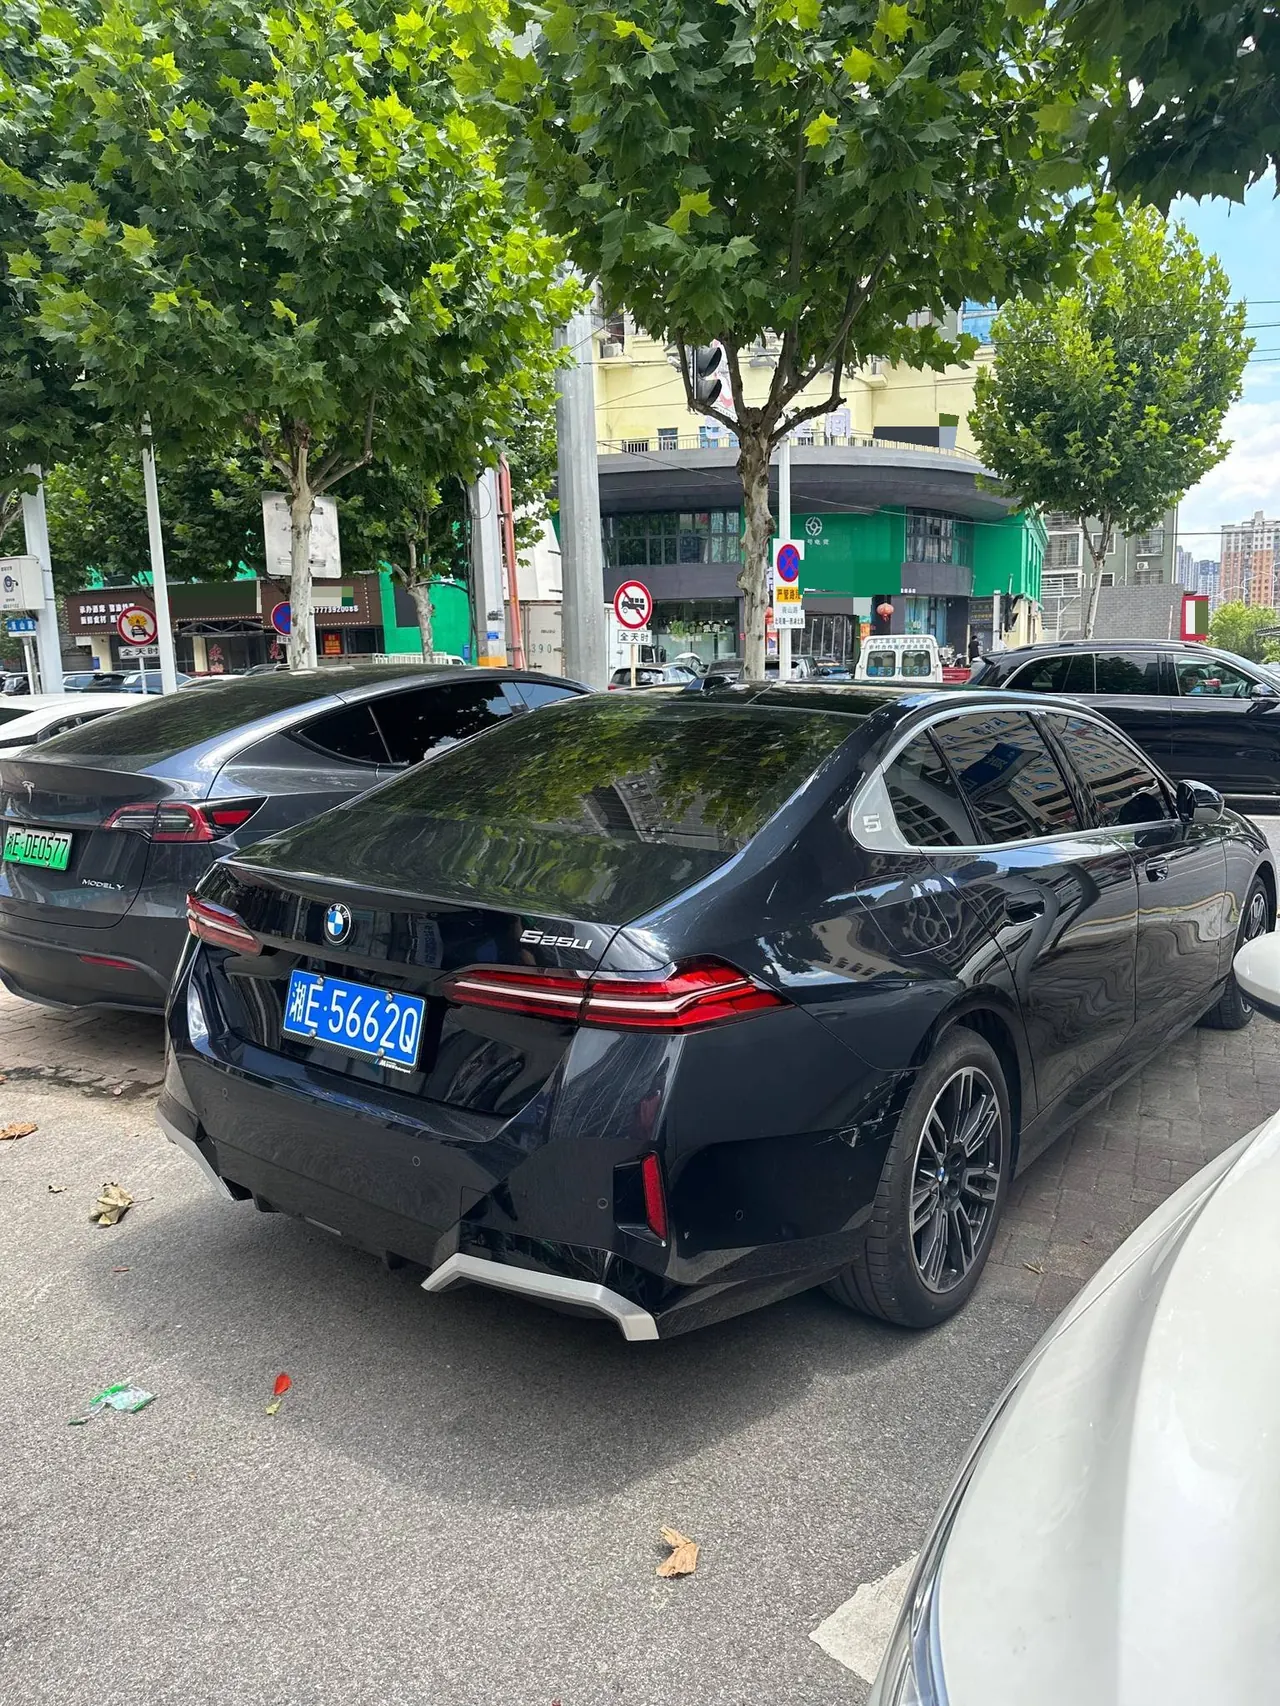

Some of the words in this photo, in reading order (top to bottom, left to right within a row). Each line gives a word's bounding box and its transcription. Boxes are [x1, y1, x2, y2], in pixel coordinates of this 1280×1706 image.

[620, 632, 649, 643] 全天时
[868, 666, 929, 676] E37139
[862, 813, 882, 833] 5
[82, 879, 115, 891] MODEL
[116, 883, 125, 891] Y
